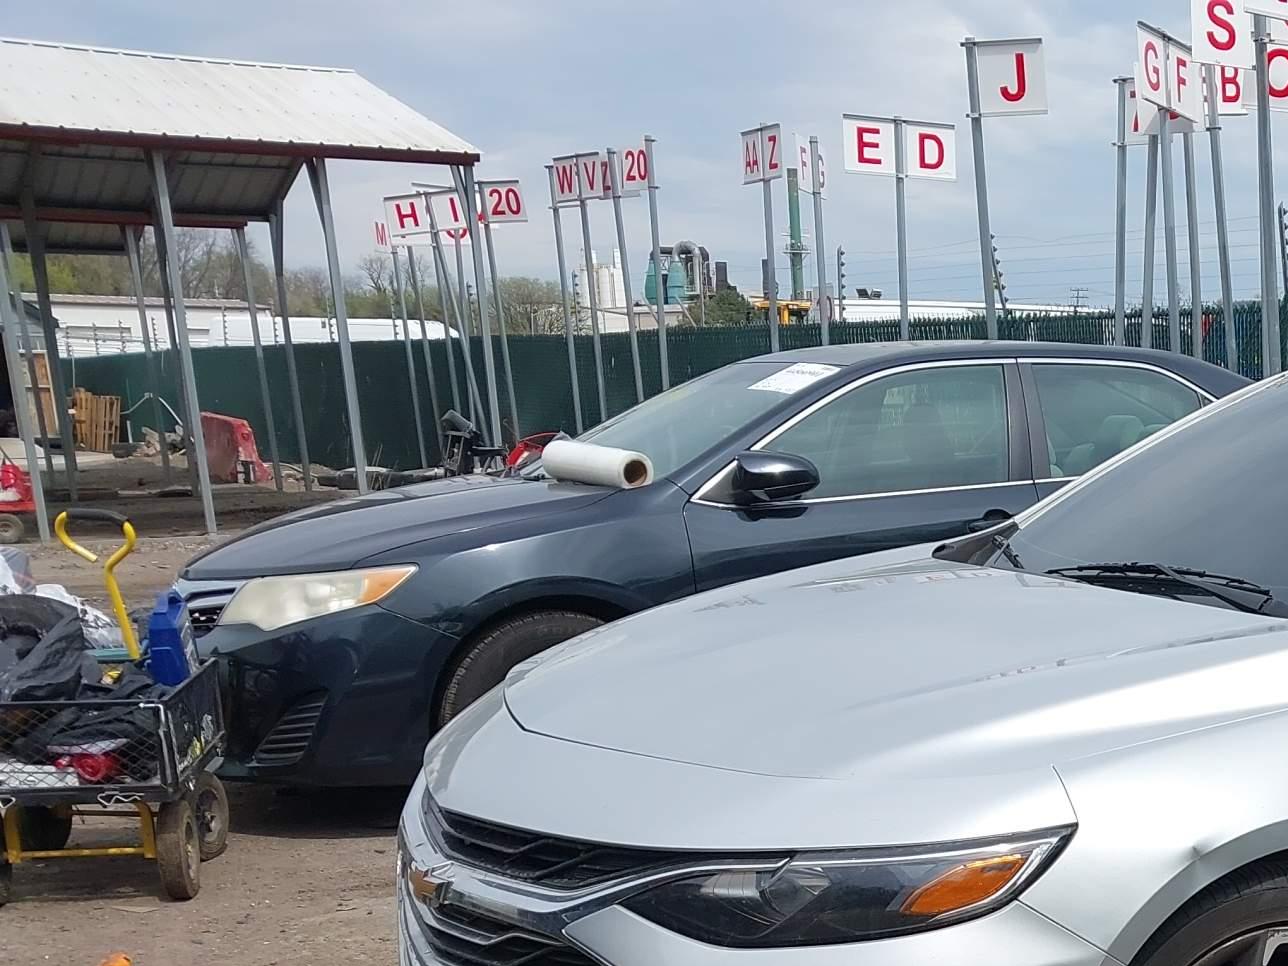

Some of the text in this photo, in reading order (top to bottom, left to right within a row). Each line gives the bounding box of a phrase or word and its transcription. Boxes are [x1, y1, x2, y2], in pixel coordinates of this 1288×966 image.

[1207, 0, 1236, 50] S
[1000, 52, 1026, 102] J
[1144, 41, 1187, 103] G F
[1220, 66, 1241, 103] B
[625, 149, 648, 182] 20
[745, 134, 779, 176] AA Z
[856, 126, 945, 170] E D
[555, 164, 573, 195] W
[583, 160, 596, 191] V
[394, 196, 459, 229] H I
[488, 187, 521, 216] 20
[374, 221, 388, 246] M
